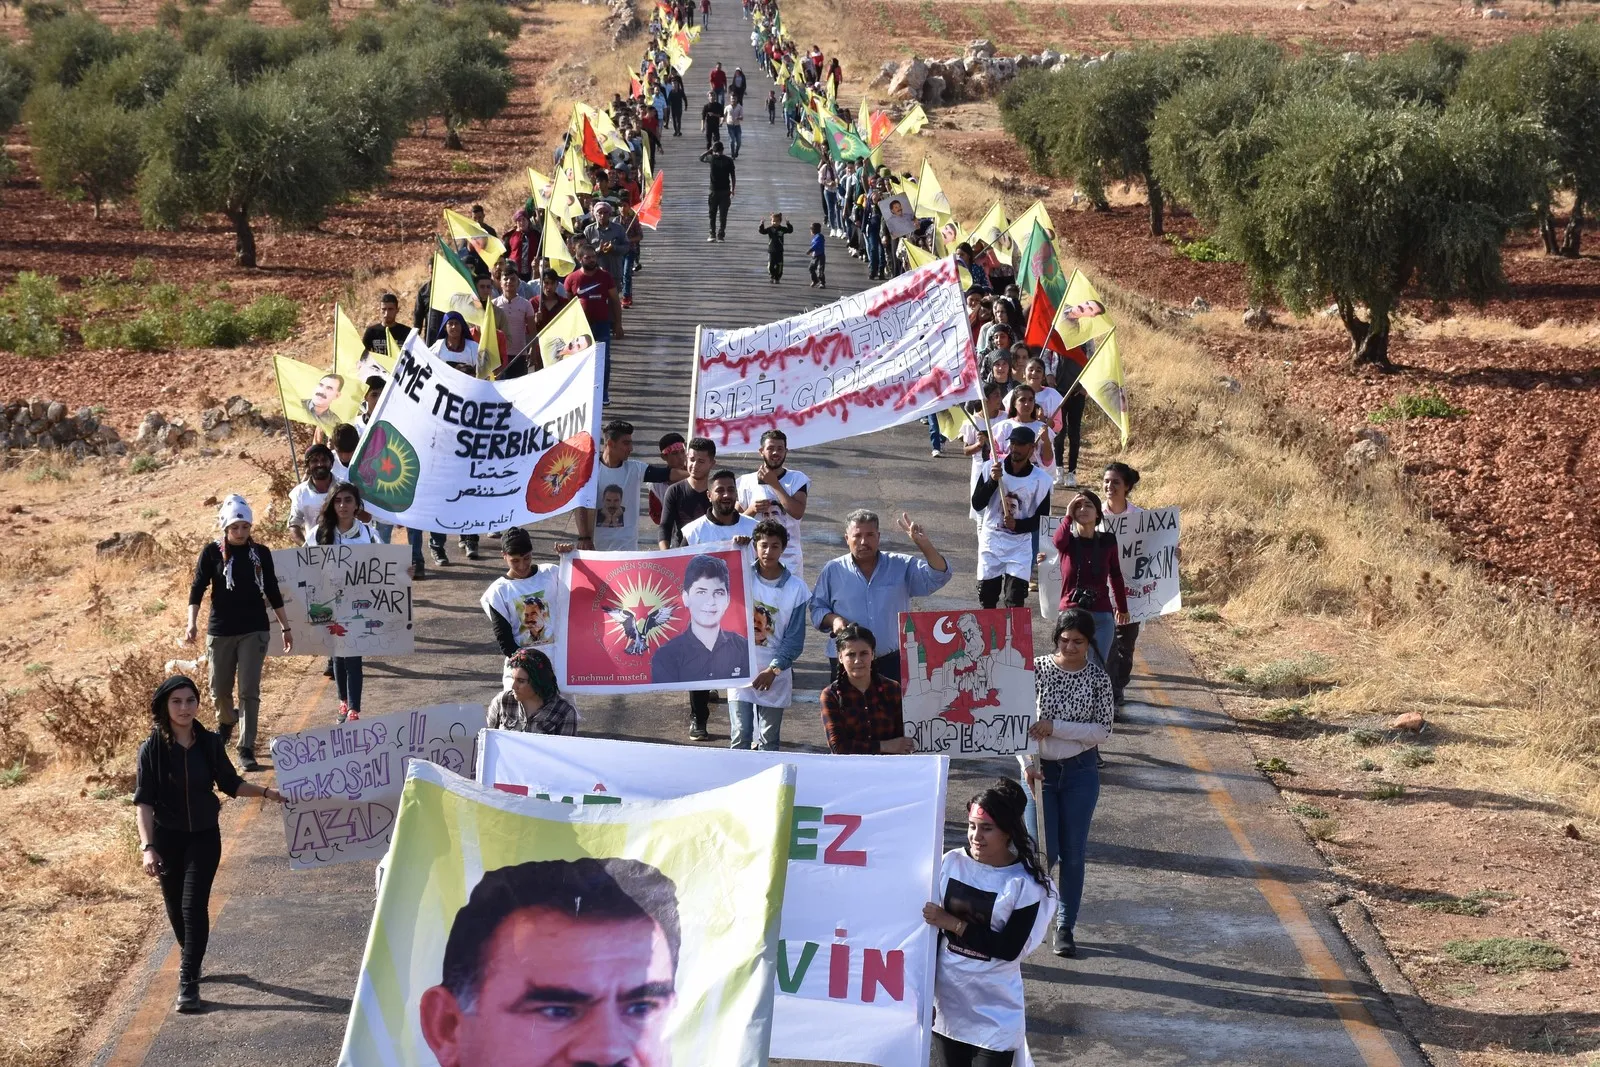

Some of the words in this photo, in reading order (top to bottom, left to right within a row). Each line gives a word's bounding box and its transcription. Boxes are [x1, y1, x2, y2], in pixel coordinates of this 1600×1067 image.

[432, 383, 512, 431] TEQEZ
[297, 545, 352, 570] NEYAR
[1122, 540, 1143, 559] ME
[345, 557, 397, 586] NABE
[291, 802, 395, 852] AZAD
